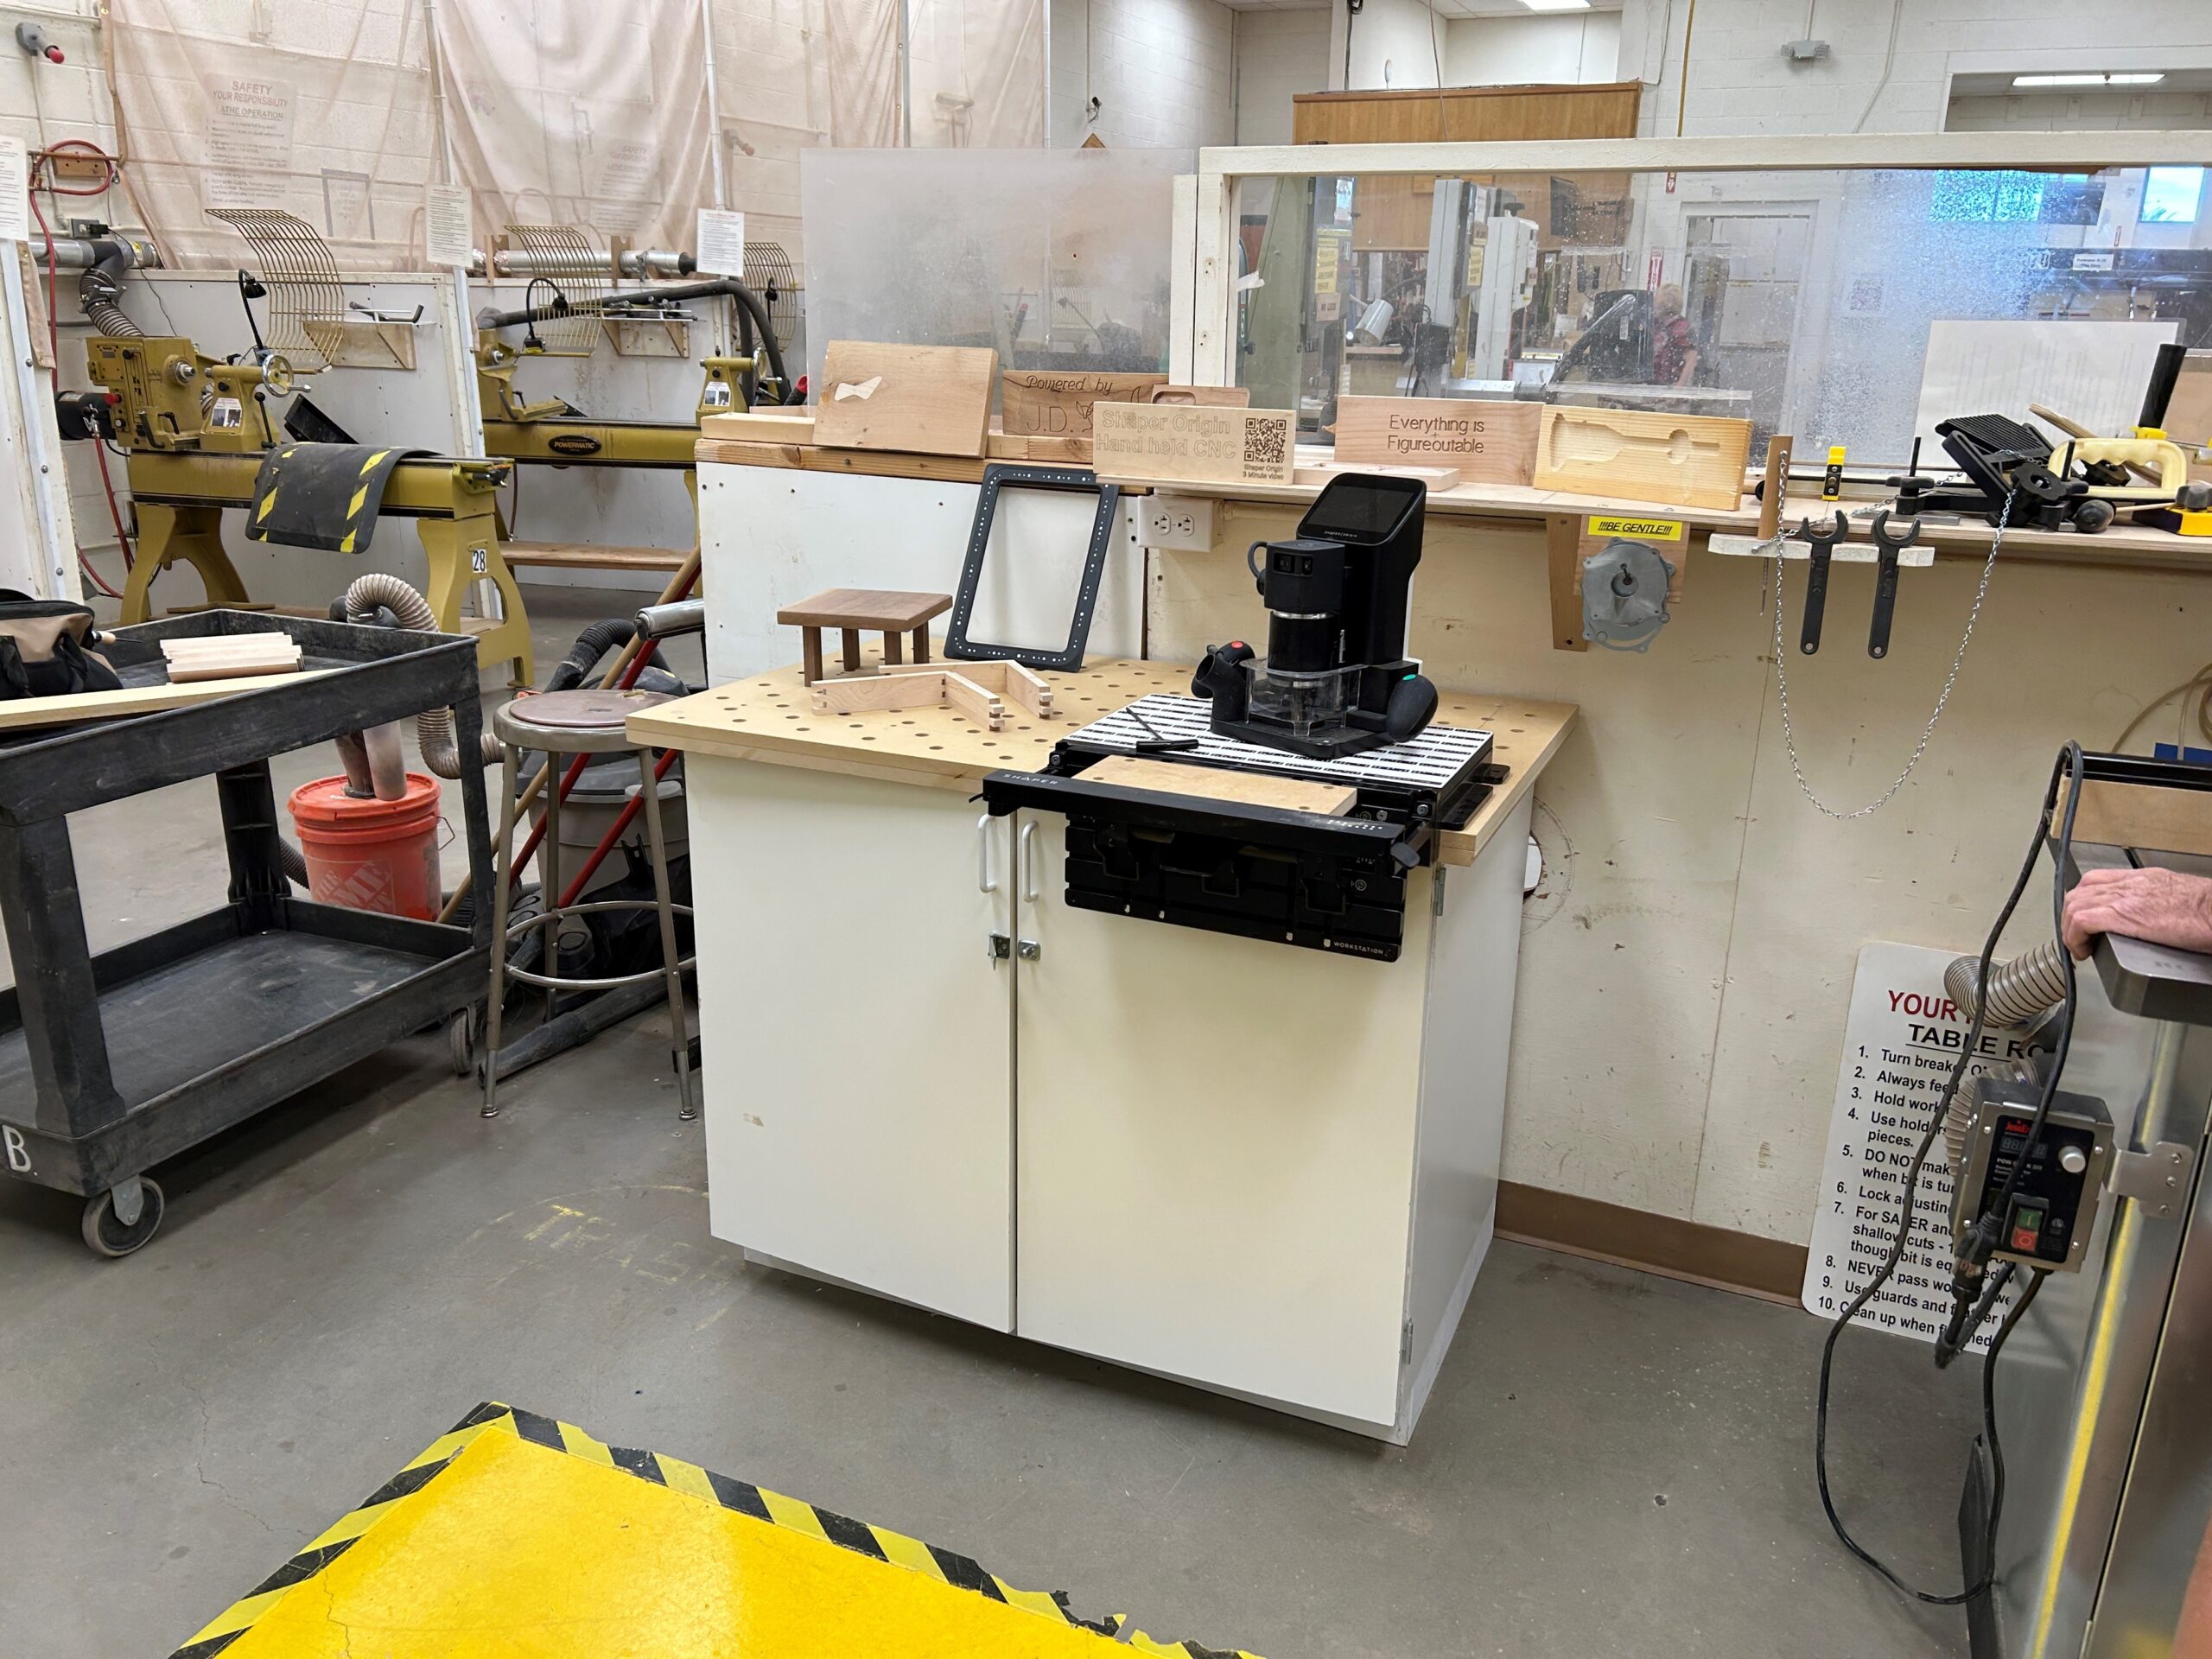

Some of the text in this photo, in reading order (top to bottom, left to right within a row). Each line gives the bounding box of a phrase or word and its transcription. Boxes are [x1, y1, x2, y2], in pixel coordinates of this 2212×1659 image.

[213, 90, 232, 101] YOUR
[232, 81, 272, 95] SAFETY
[1026, 375, 1113, 395] Powered by
[1102, 410, 1230, 437] Shaper Origin
[1390, 415, 1484, 435] Everything is
[1096, 434, 1236, 459] Hand held CNC
[1388, 435, 1484, 454] Figureoutable
[474, 550, 485, 571] 28
[1003, 774, 1058, 785] SHAPER
[1334, 941, 1383, 955] WORKSTATION
[1888, 990, 1958, 1021] YOUR
[1859, 1046, 1868, 1058] 1.
[1881, 1048, 1910, 1065] Turn
[1854, 1066, 1866, 1079] 2.
[1877, 1070, 1925, 1090] Always
[1851, 1087, 1862, 1100] 3.
[1874, 1090, 1905, 1107] Hold
[1847, 1108, 1859, 1120] 4.
[1871, 1111, 1896, 1127] Use
[1867, 1129, 1914, 1147] pieces.
[1842, 1144, 1853, 1157] 5.
[1865, 1148, 1885, 1163] DO
[1922, 1161, 1950, 1176] mak
[1862, 1167, 1897, 1183] when
[1922, 1177, 1933, 1190] is
[1836, 1181, 1847, 1194] 6.
[1859, 1185, 1891, 1202] Lock
[1834, 1201, 1844, 1214] 7.
[1856, 1205, 1878, 1221] For
[1882, 1211, 1928, 1231] SAER
[1907, 1236, 1935, 1249] cuts
[1900, 1249, 1917, 1264] bit
[1921, 1254, 1932, 1268] is
[1825, 1255, 1836, 1268] 8.
[1897, 1273, 1928, 1287] pass
[1822, 1275, 1833, 1288] 9.
[1872, 1288, 1917, 1307] guards
[1922, 1300, 1947, 1313] and
[1818, 1296, 1835, 1311] 10.
[1879, 1313, 1896, 1327] up
[1901, 1317, 1935, 1334] when
